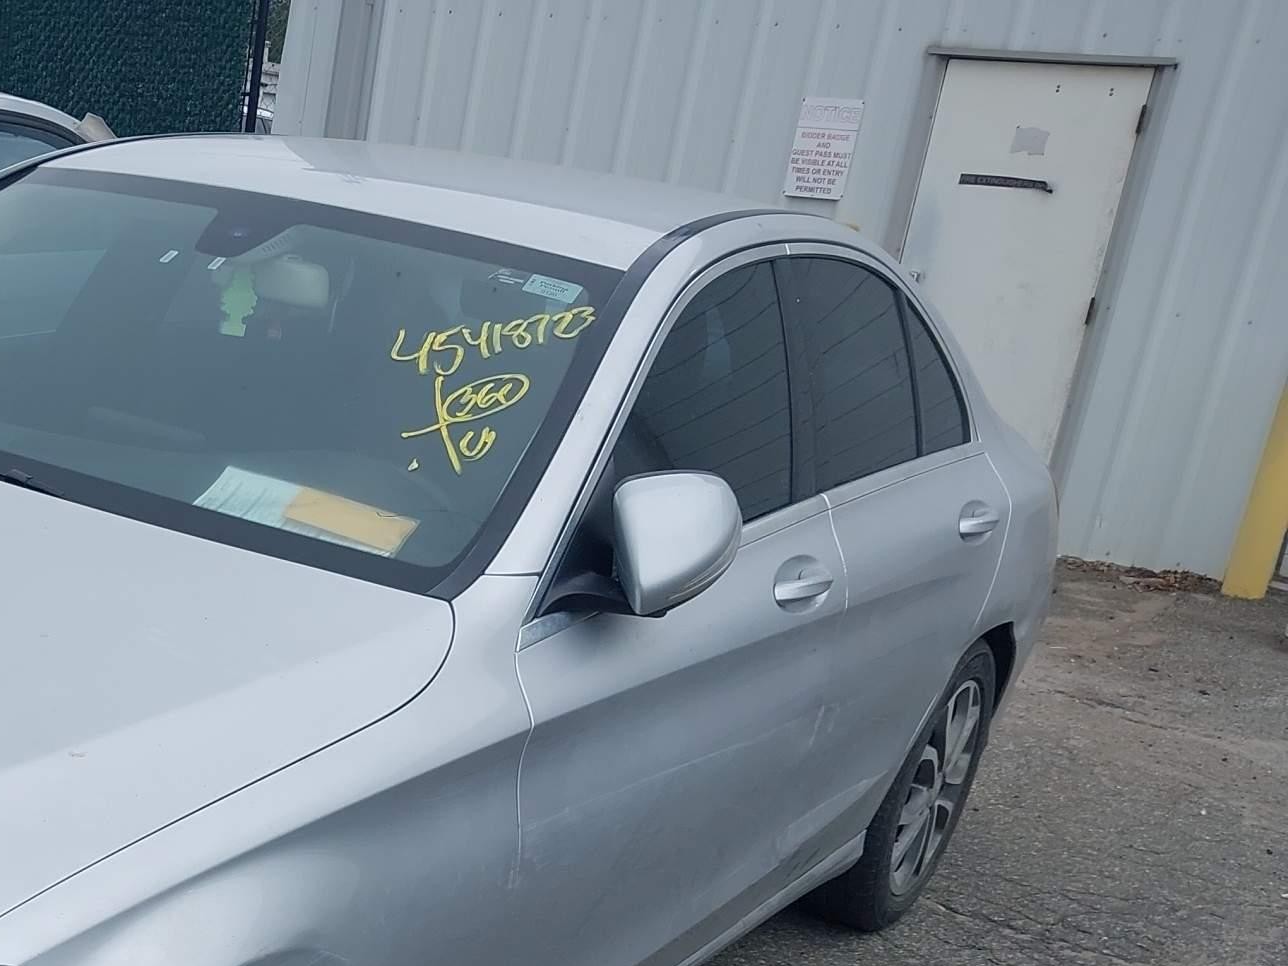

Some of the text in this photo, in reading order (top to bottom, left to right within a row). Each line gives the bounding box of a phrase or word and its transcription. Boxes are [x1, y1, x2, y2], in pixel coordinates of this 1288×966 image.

[800, 104, 862, 124] NOTICE
[792, 149, 814, 157] GUEST
[790, 157, 800, 165] BE
[801, 158, 826, 166] VISIBLE
[792, 166, 810, 175] TIMES
[822, 169, 844, 177] ENTRY
[812, 177, 826, 185] NOT
[827, 178, 837, 186] BE
[794, 185, 832, 194] PERMITTED
[391, 307, 596, 375] 45418723
